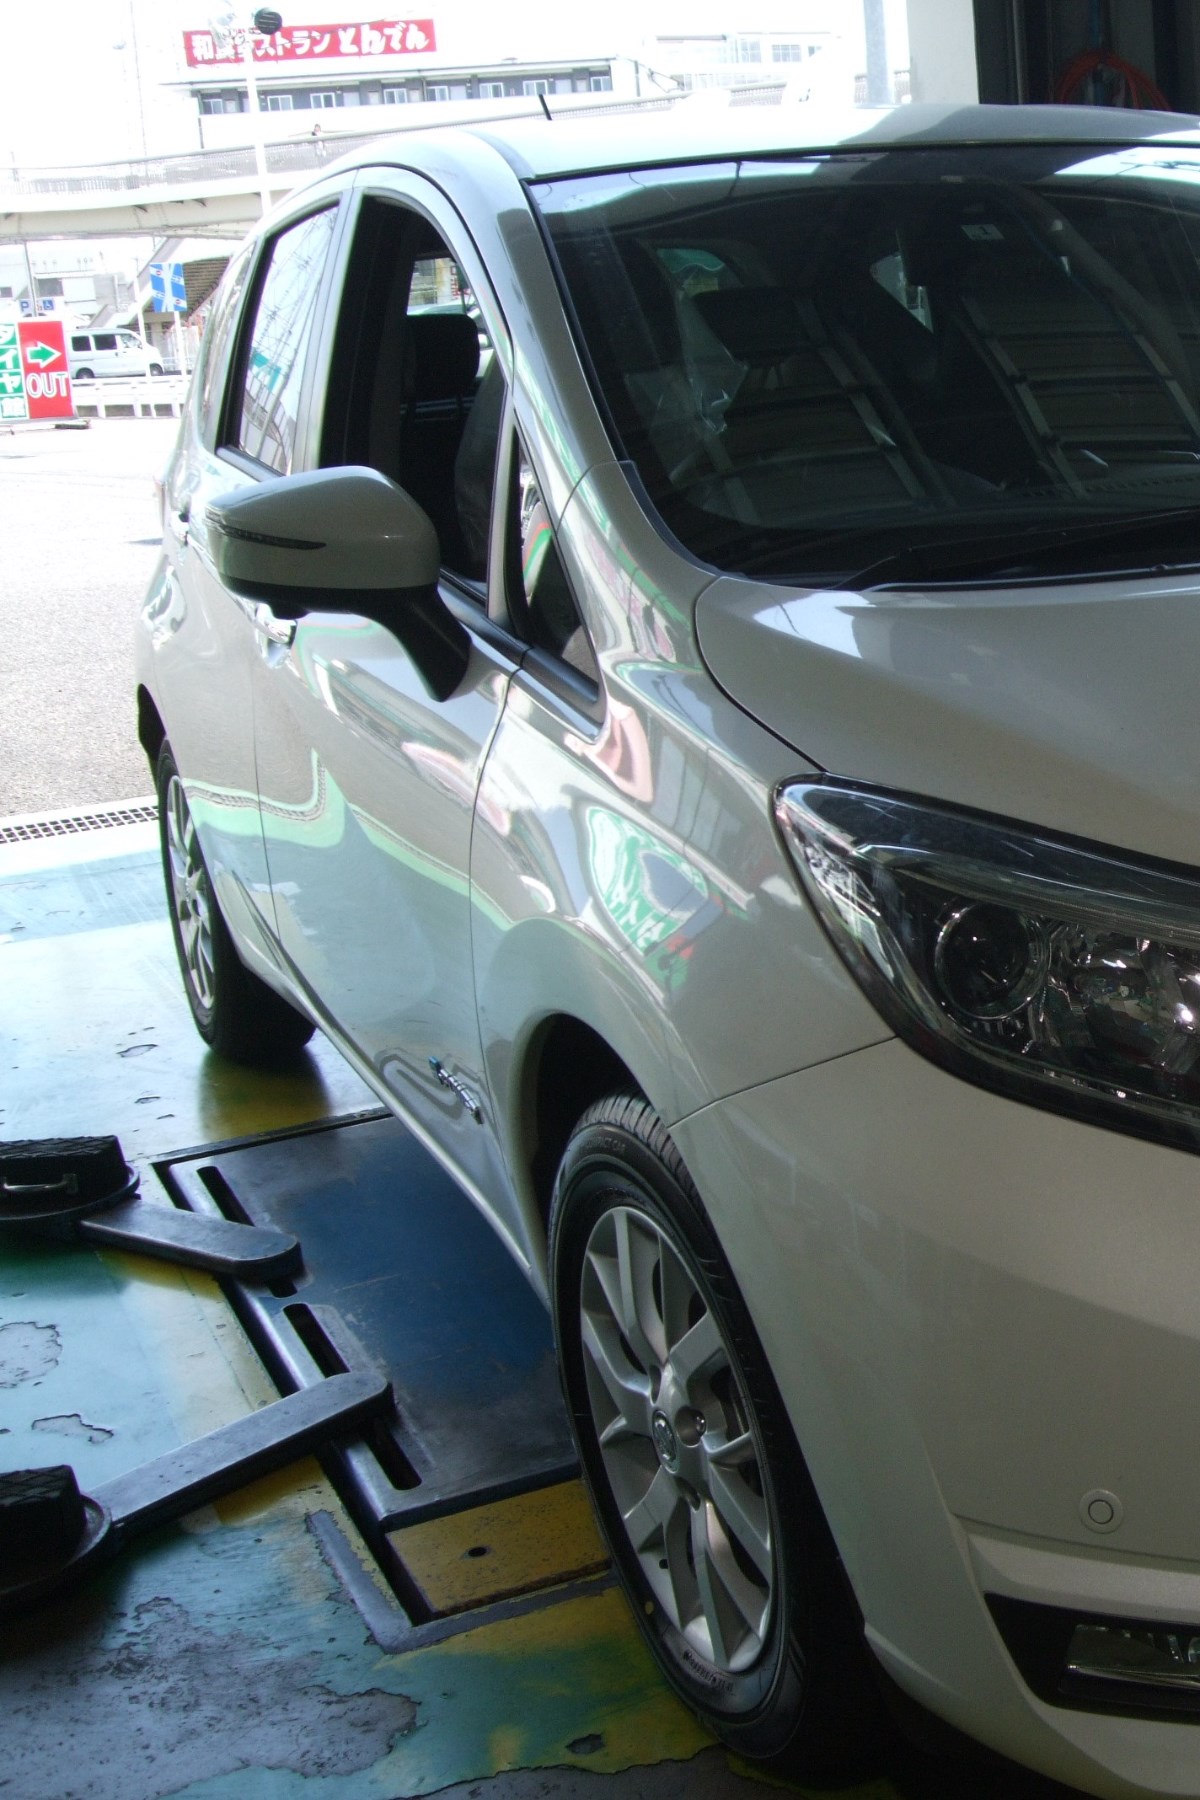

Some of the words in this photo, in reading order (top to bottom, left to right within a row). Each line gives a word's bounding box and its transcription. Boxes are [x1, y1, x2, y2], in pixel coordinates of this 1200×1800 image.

[192, 32, 331, 61] 和ストラン
[338, 20, 430, 55] とんでん
[27, 372, 68, 398] OUT
